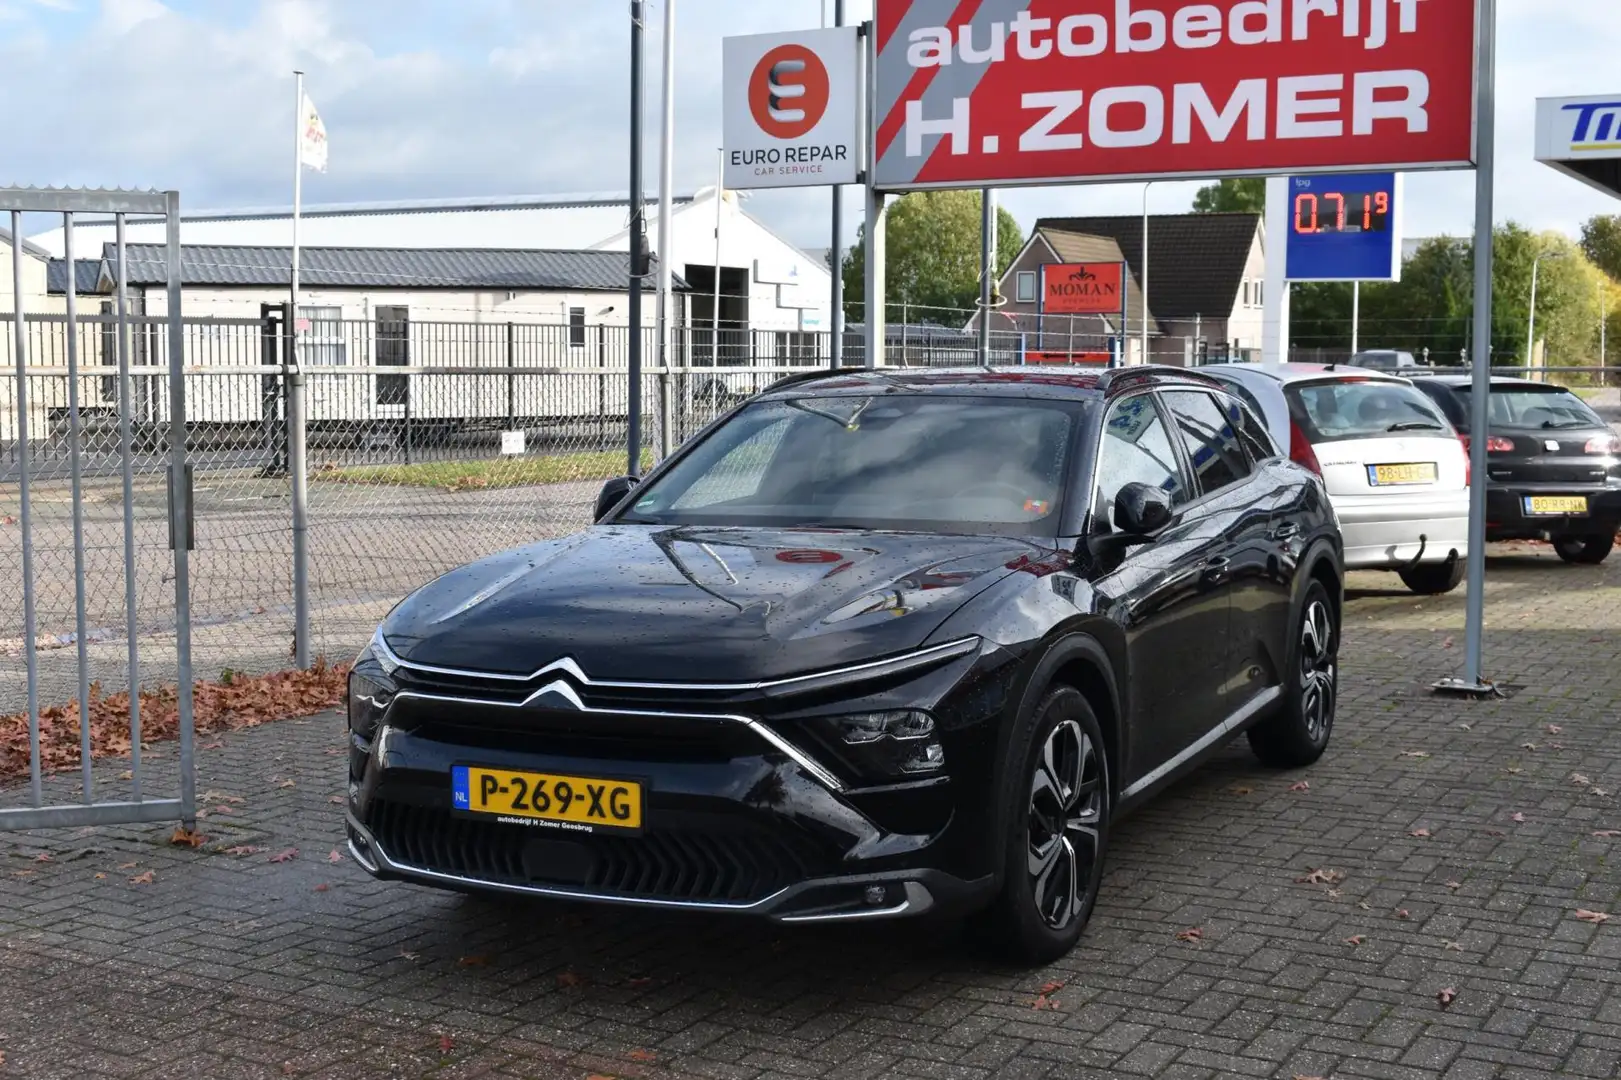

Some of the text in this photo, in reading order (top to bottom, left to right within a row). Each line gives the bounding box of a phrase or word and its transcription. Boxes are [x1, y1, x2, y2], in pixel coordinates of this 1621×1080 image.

[904, 69, 1431, 157] H. ZOMER
[731, 145, 848, 166] EURO REPAR
[754, 164, 823, 176] CAR SERVICE
[1050, 282, 1117, 297] MOMAN
[454, 774, 631, 821] NL P-269-XG
[497, 816, 532, 827] autobedrijf
[532, 819, 539, 827] H
[539, 820, 561, 829] Zomer
